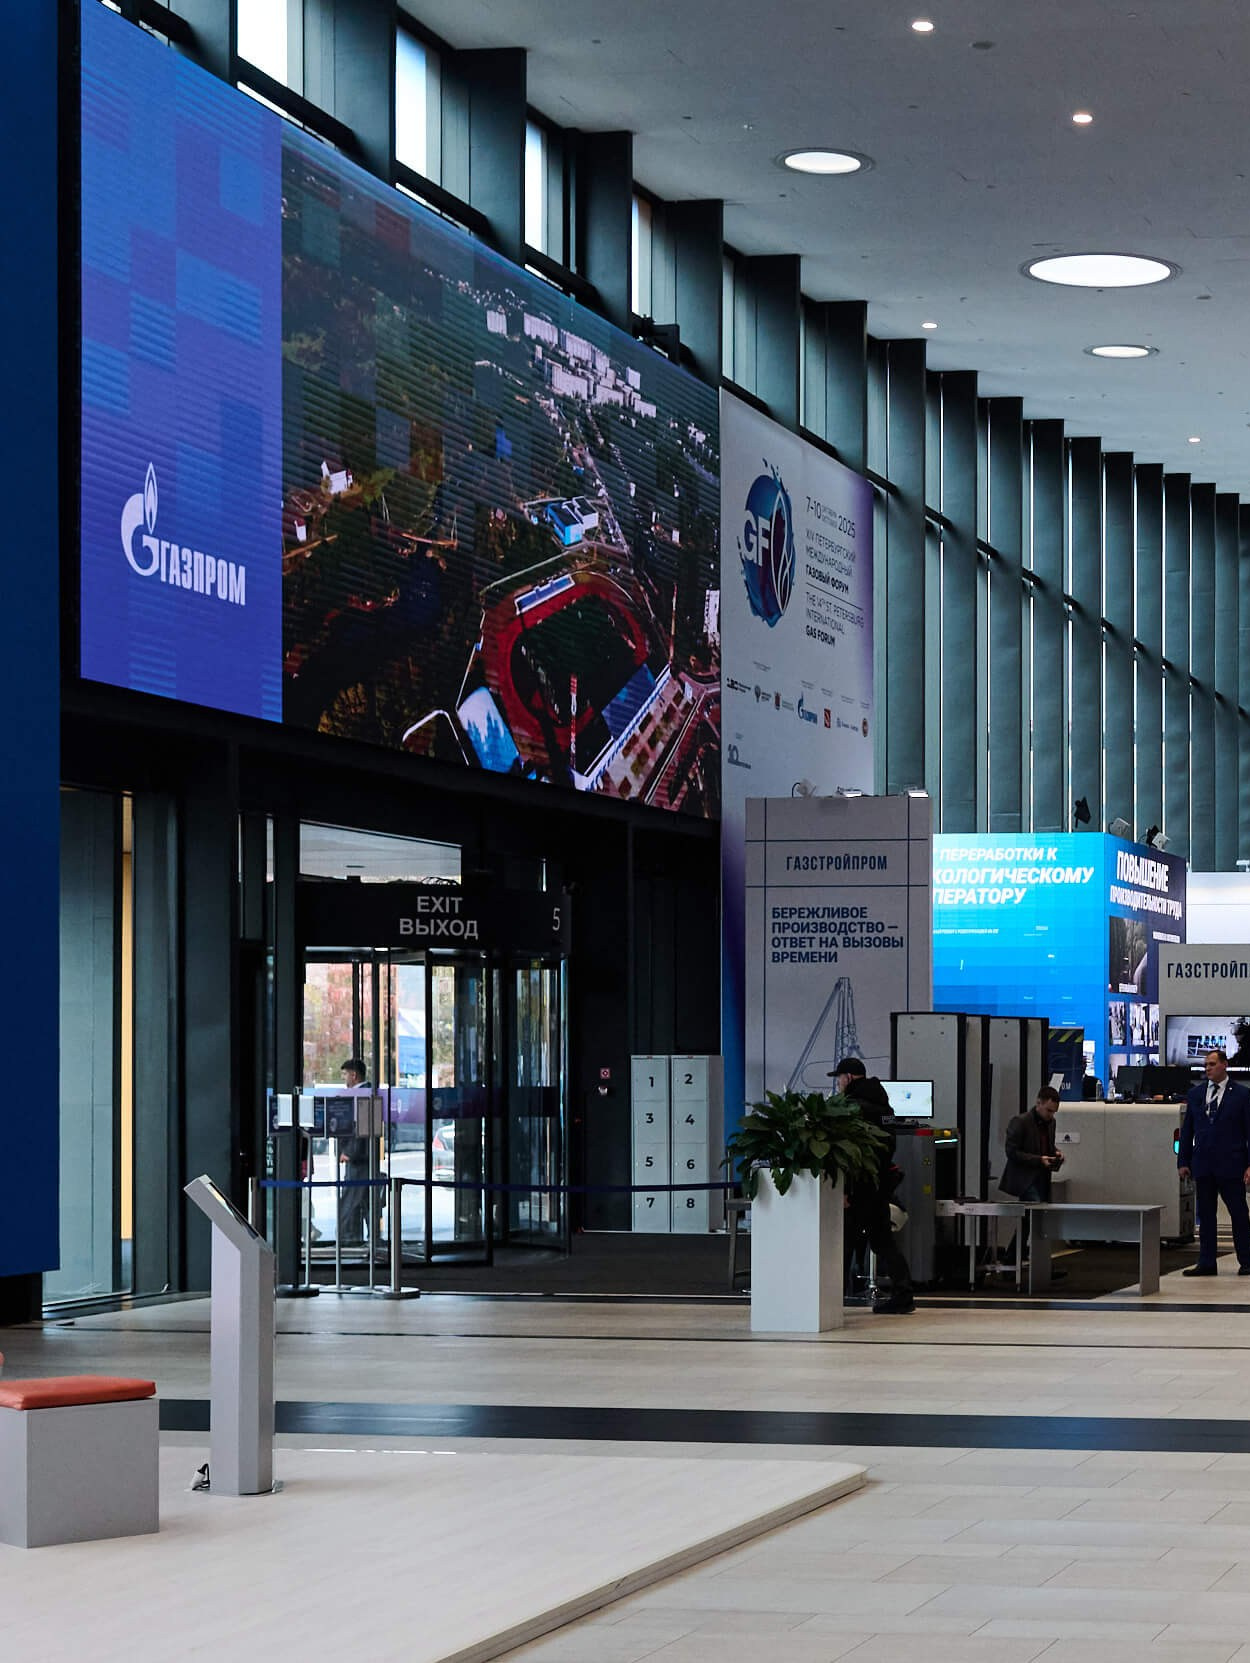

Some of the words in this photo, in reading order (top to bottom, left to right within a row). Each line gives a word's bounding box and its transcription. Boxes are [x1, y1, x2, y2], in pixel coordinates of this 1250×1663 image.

[838, 515, 856, 539] 2025
[160, 540, 246, 606] ГАЗПРОМ
[806, 564, 830, 584] ГАЗОВЫЙ
[831, 577, 849, 594] ФОРУМ
[806, 625, 817, 639] GAS
[818, 629, 836, 647] FORUM
[940, 847, 1044, 861] ПЕРЕРАБОТКИ
[1046, 847, 1058, 861] К
[786, 853, 888, 871] ГАЗСТРОЙПРОМ
[1117, 850, 1169, 893] ПОВЫШЕНИЕ
[417, 895, 463, 914] EXIT
[552, 907, 561, 931] 5
[772, 907, 868, 919] БЕРЕЖЛИВОЕ
[399, 918, 479, 940] ВЫХОД
[772, 922, 885, 935] ПРОИЗВОДСТВО
[771, 936, 816, 948] ОТВЕТ
[819, 936, 839, 948] НА
[842, 936, 904, 949] ВЫЗОВЫ
[772, 951, 838, 963] ВРЕМЕНИ
[649, 1076, 655, 1087] 1
[684, 1073, 693, 1085] 2
[645, 1113, 654, 1124] 3
[685, 1114, 695, 1125] 4
[645, 1156, 653, 1167] 5
[686, 1159, 695, 1170] 6
[646, 1197, 655, 1208] 7
[686, 1198, 695, 1208] 8
